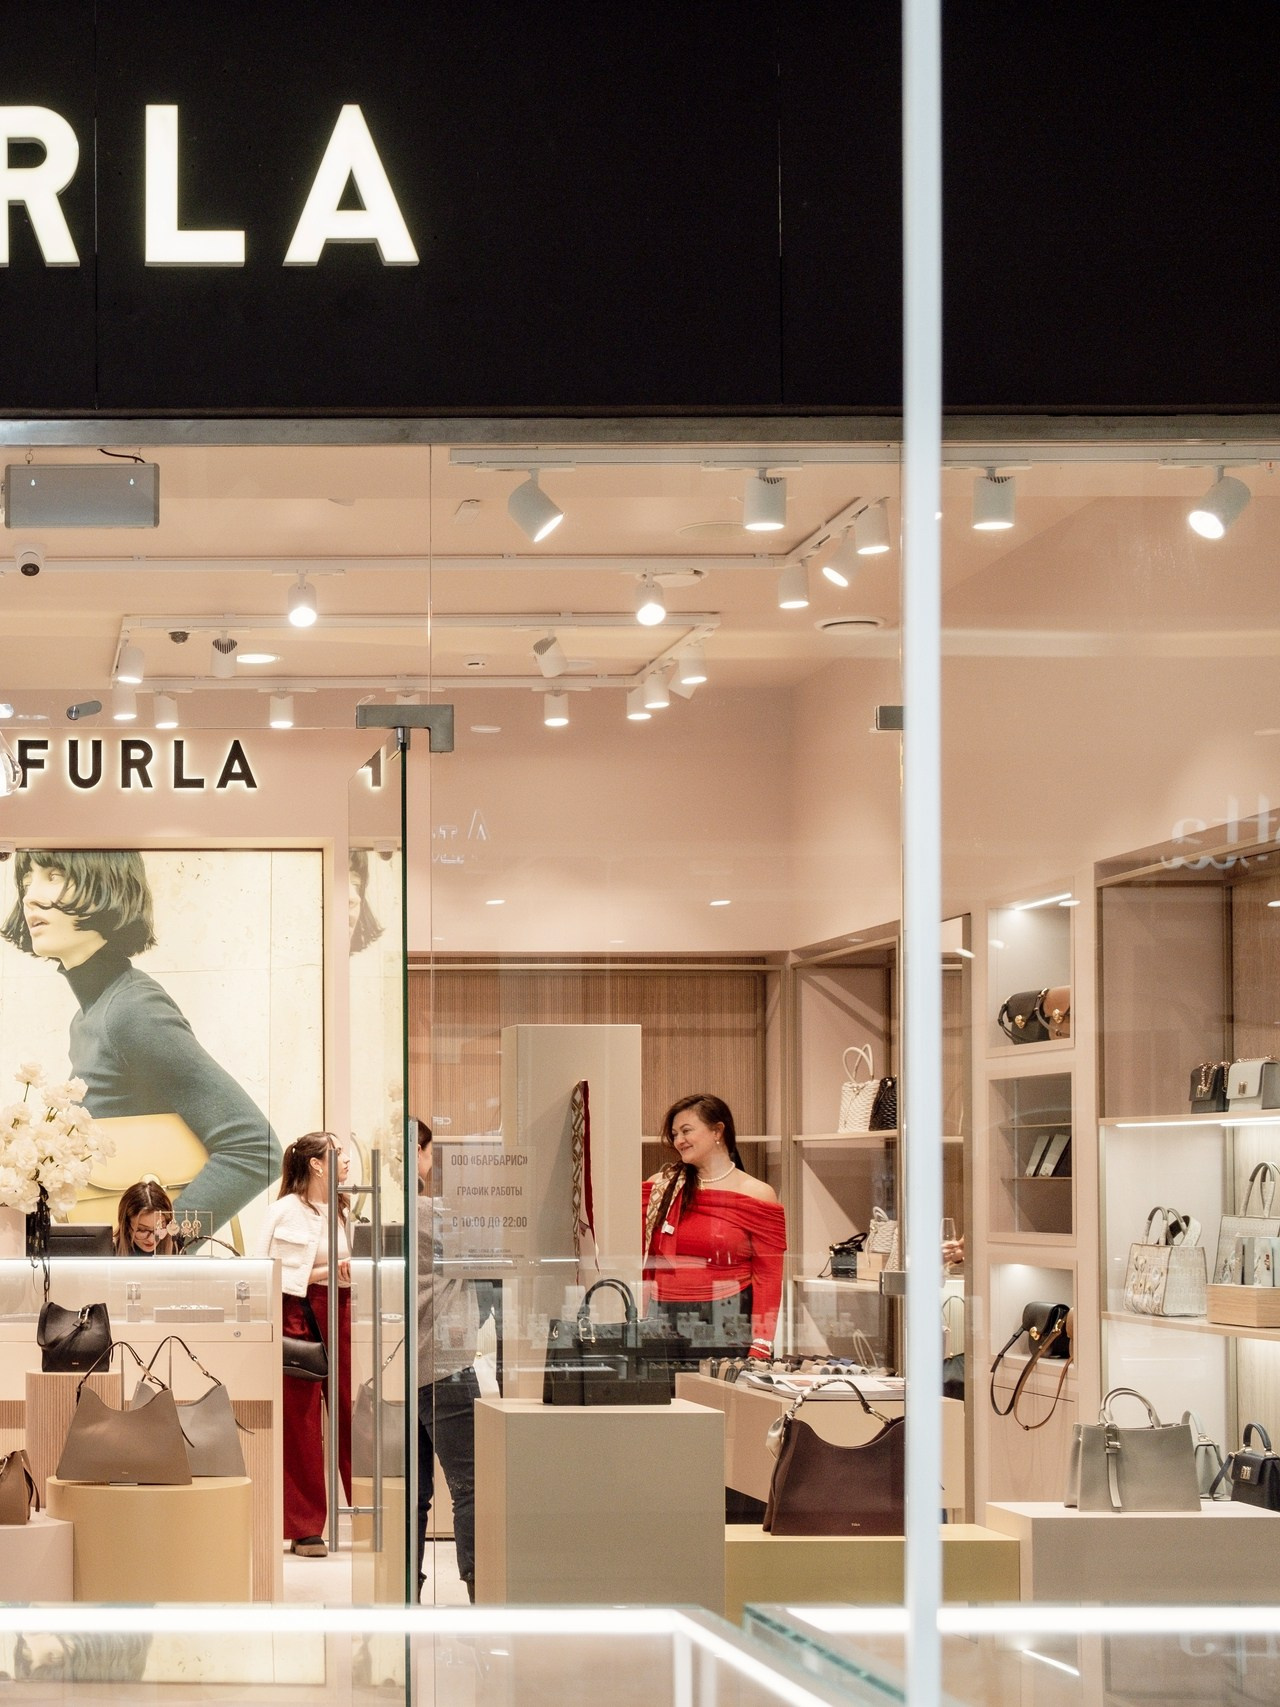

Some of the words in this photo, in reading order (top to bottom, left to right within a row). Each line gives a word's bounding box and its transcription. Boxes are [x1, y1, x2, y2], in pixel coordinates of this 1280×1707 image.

[17, 739, 258, 789] FURLA
[451, 1154, 468, 1166] ООО
[471, 1154, 528, 1166] «БАРБАРИС»
[457, 1186, 489, 1196] ГРАФИК
[490, 1186, 523, 1196] РАБОТЫ
[452, 1217, 458, 1227] С
[461, 1217, 485, 1227] 10:00
[487, 1217, 500, 1229] ДО
[502, 1217, 528, 1227] 22:00
